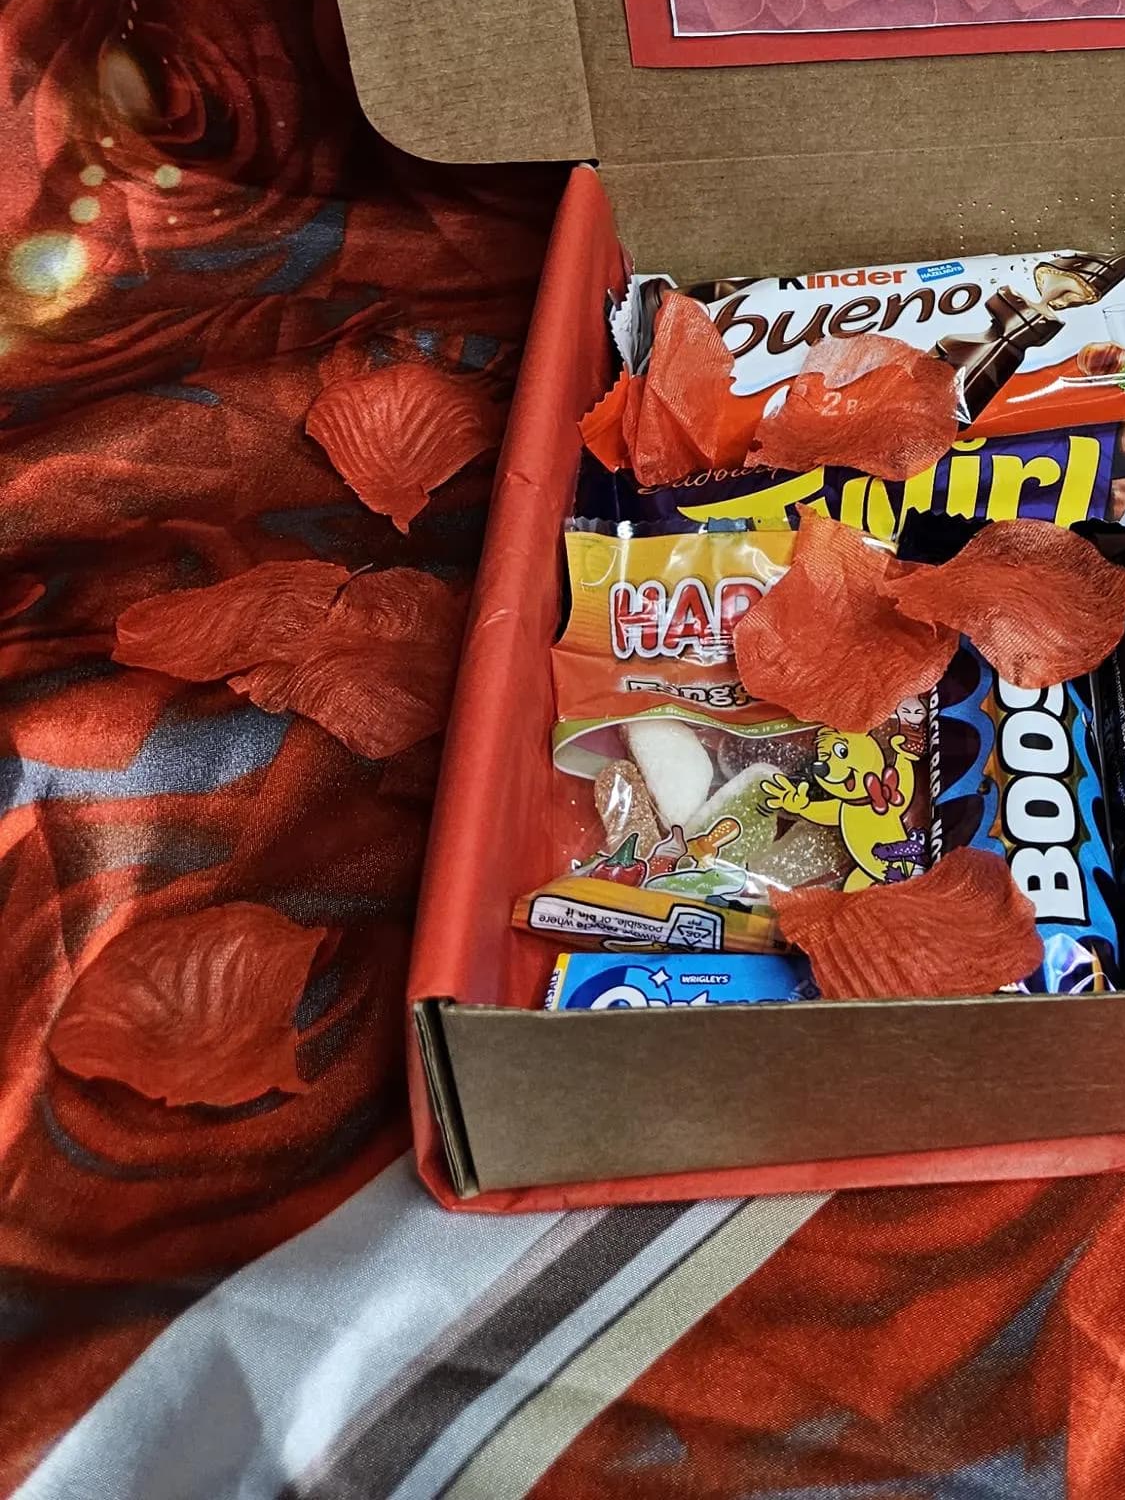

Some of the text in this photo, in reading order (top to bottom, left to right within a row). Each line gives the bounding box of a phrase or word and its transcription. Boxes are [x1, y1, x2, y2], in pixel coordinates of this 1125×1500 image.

[921, 266, 962, 279] HAZELNUTS
[707, 283, 982, 358] bueno
[538, 913, 573, 927] where
[578, 910, 597, 921] bin
